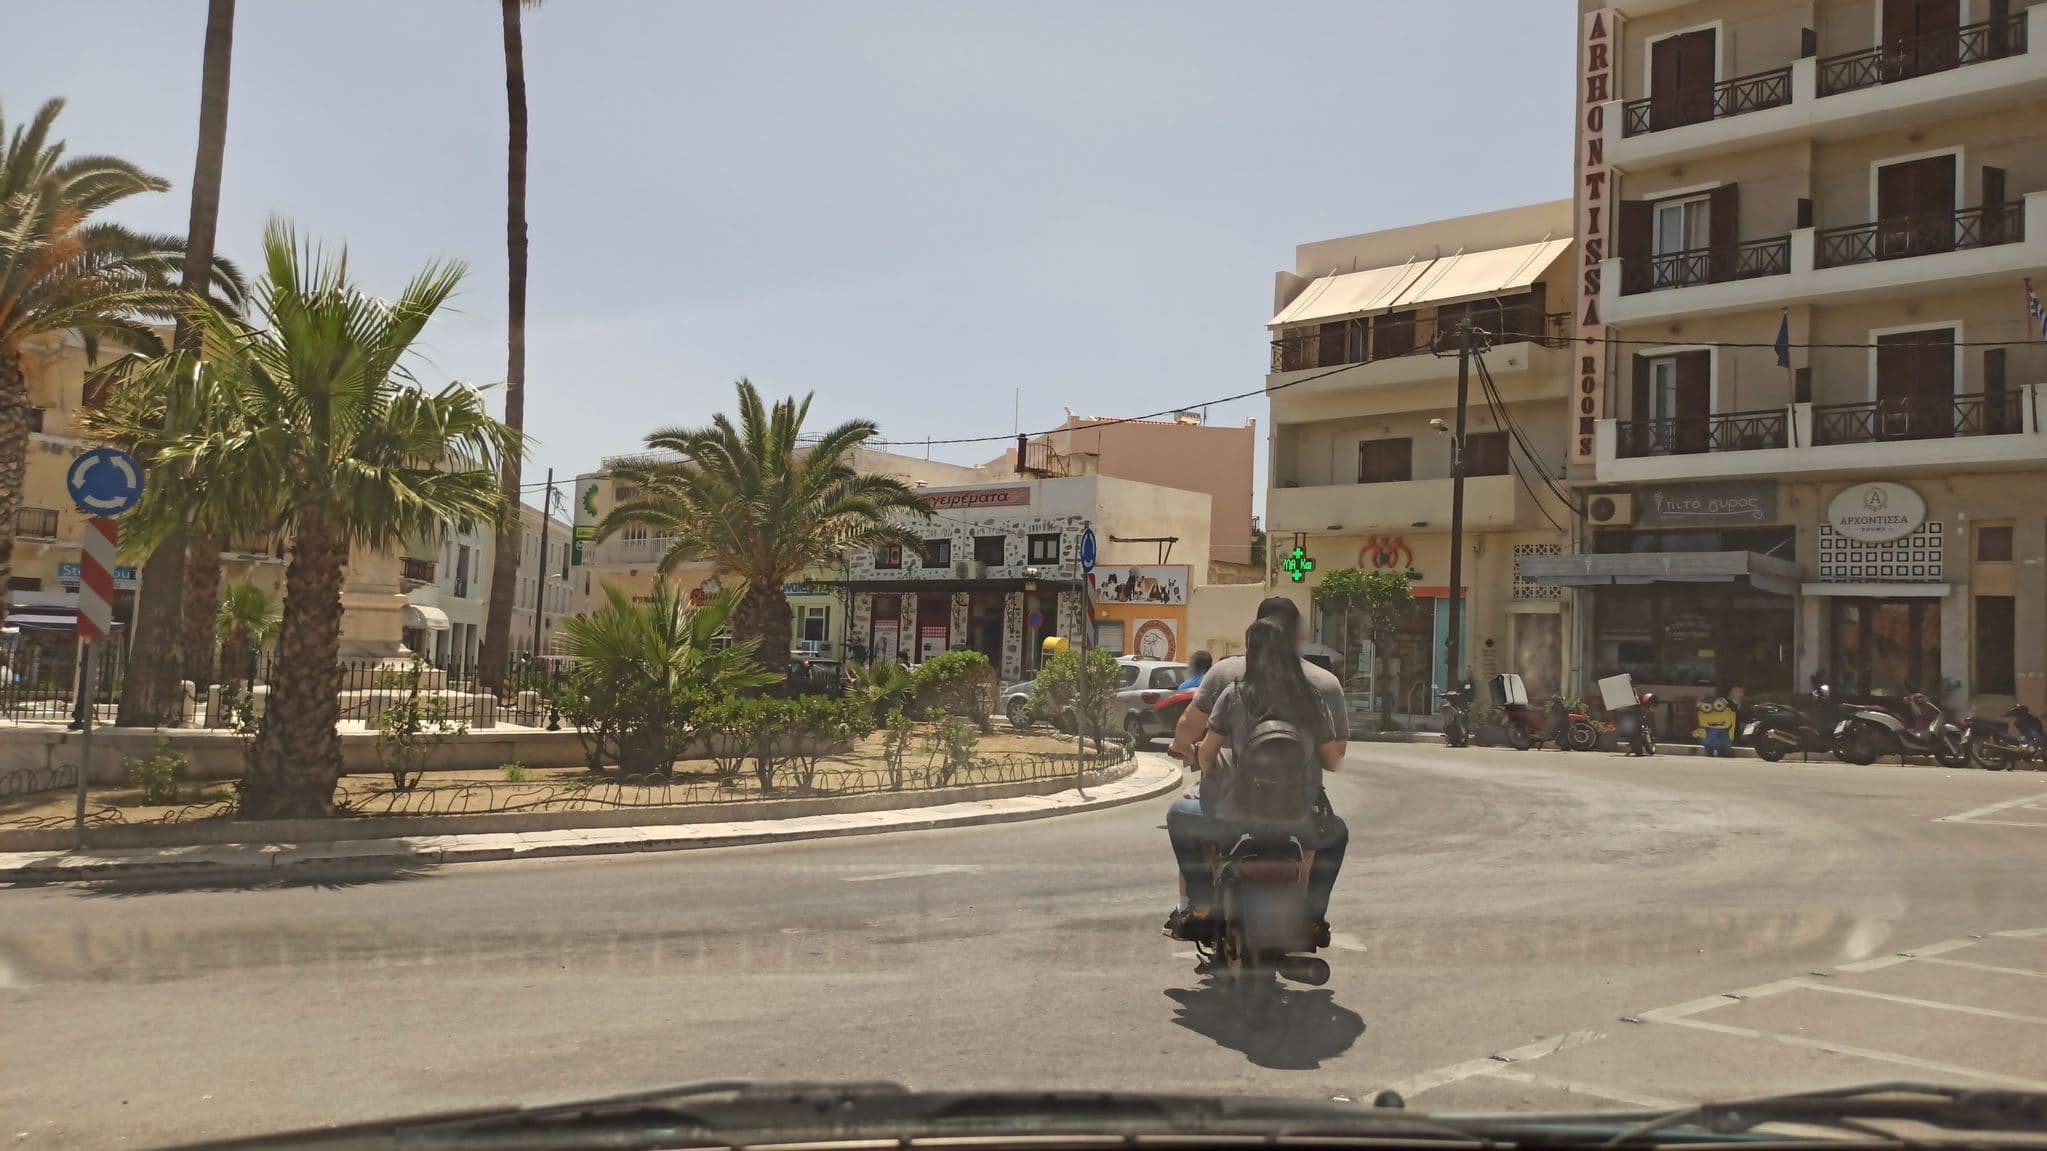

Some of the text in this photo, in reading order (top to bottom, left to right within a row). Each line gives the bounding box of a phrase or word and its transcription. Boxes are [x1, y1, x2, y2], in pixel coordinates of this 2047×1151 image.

[1579, 11, 1609, 456] ARHONTISSA ROOMS
[1839, 514, 1909, 526] ΑΡΧΟΝΤΙΣΣΑ
